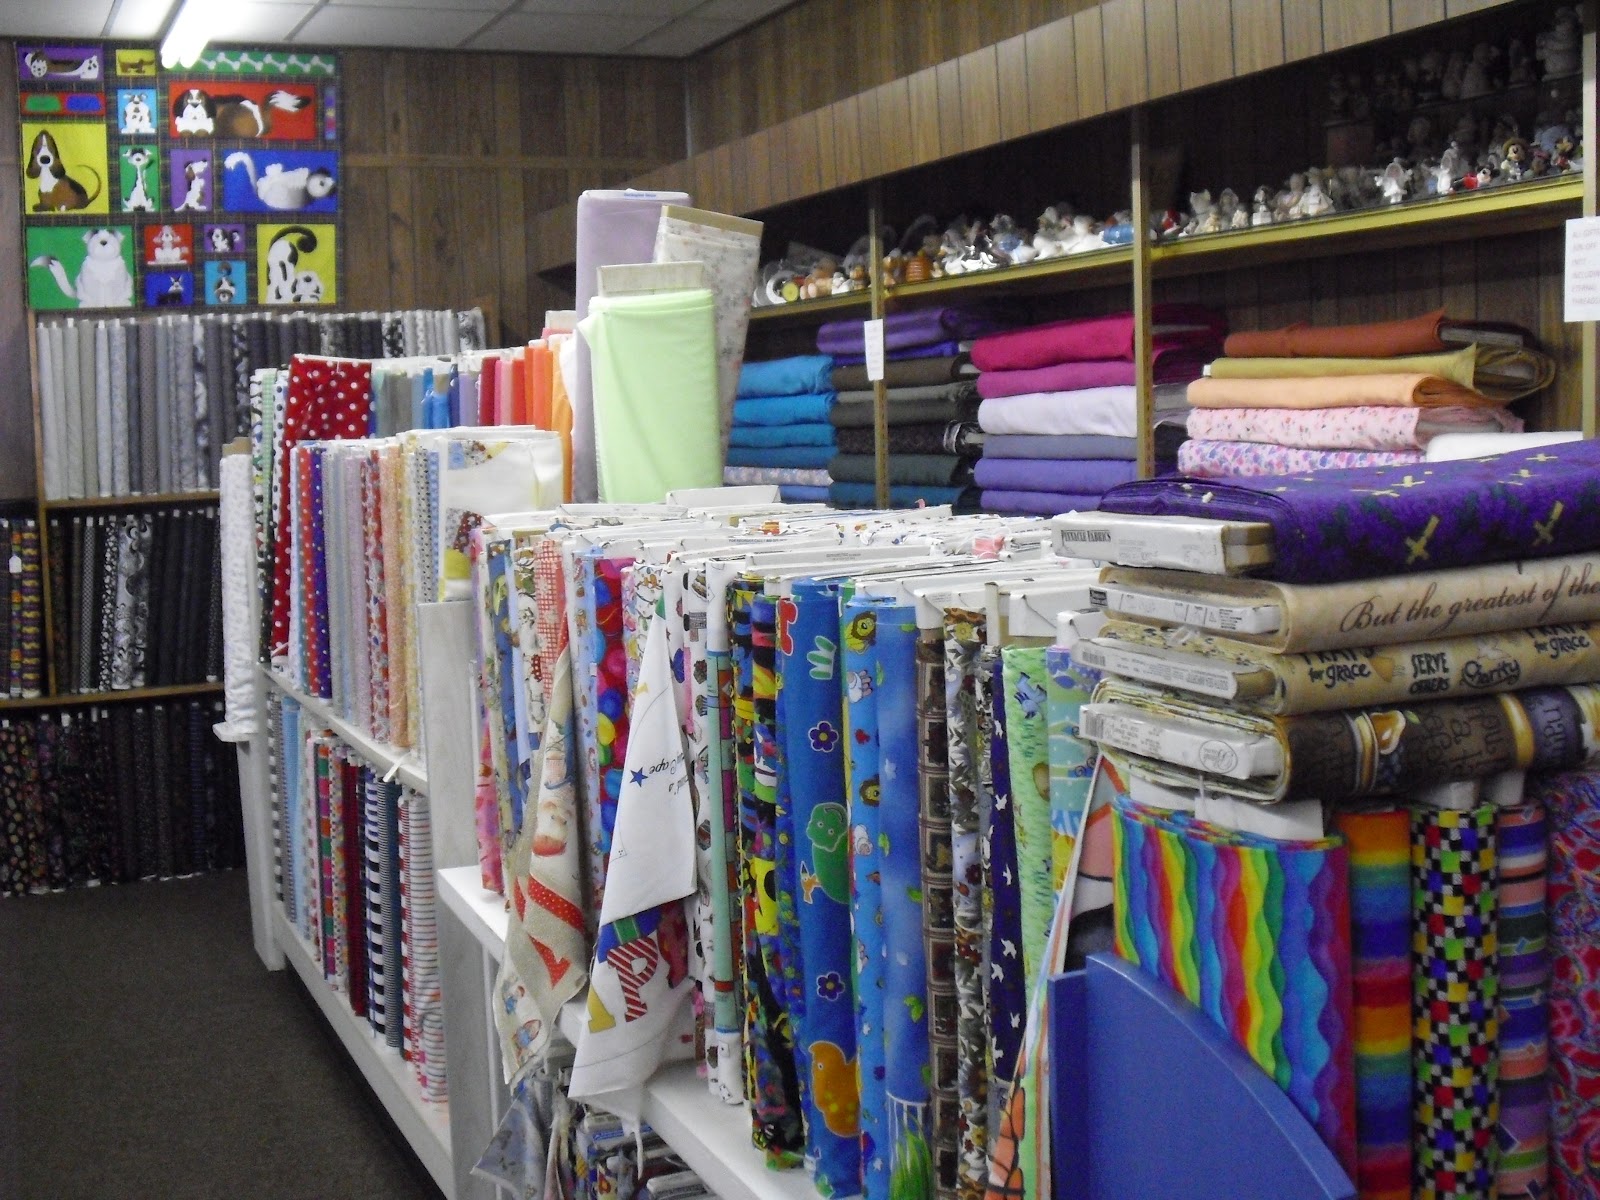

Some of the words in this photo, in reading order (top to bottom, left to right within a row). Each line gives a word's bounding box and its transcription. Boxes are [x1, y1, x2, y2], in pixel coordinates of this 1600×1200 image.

[1061, 530, 1087, 546] PINNACLE
[1087, 530, 1111, 542] FABRICS
[1340, 595, 1401, 633] But
[1406, 582, 1442, 622] the
[1429, 582, 1537, 636] greatest
[1538, 565, 1571, 623] of
[1568, 562, 1600, 598] the
[1411, 652, 1449, 679] SERVE
